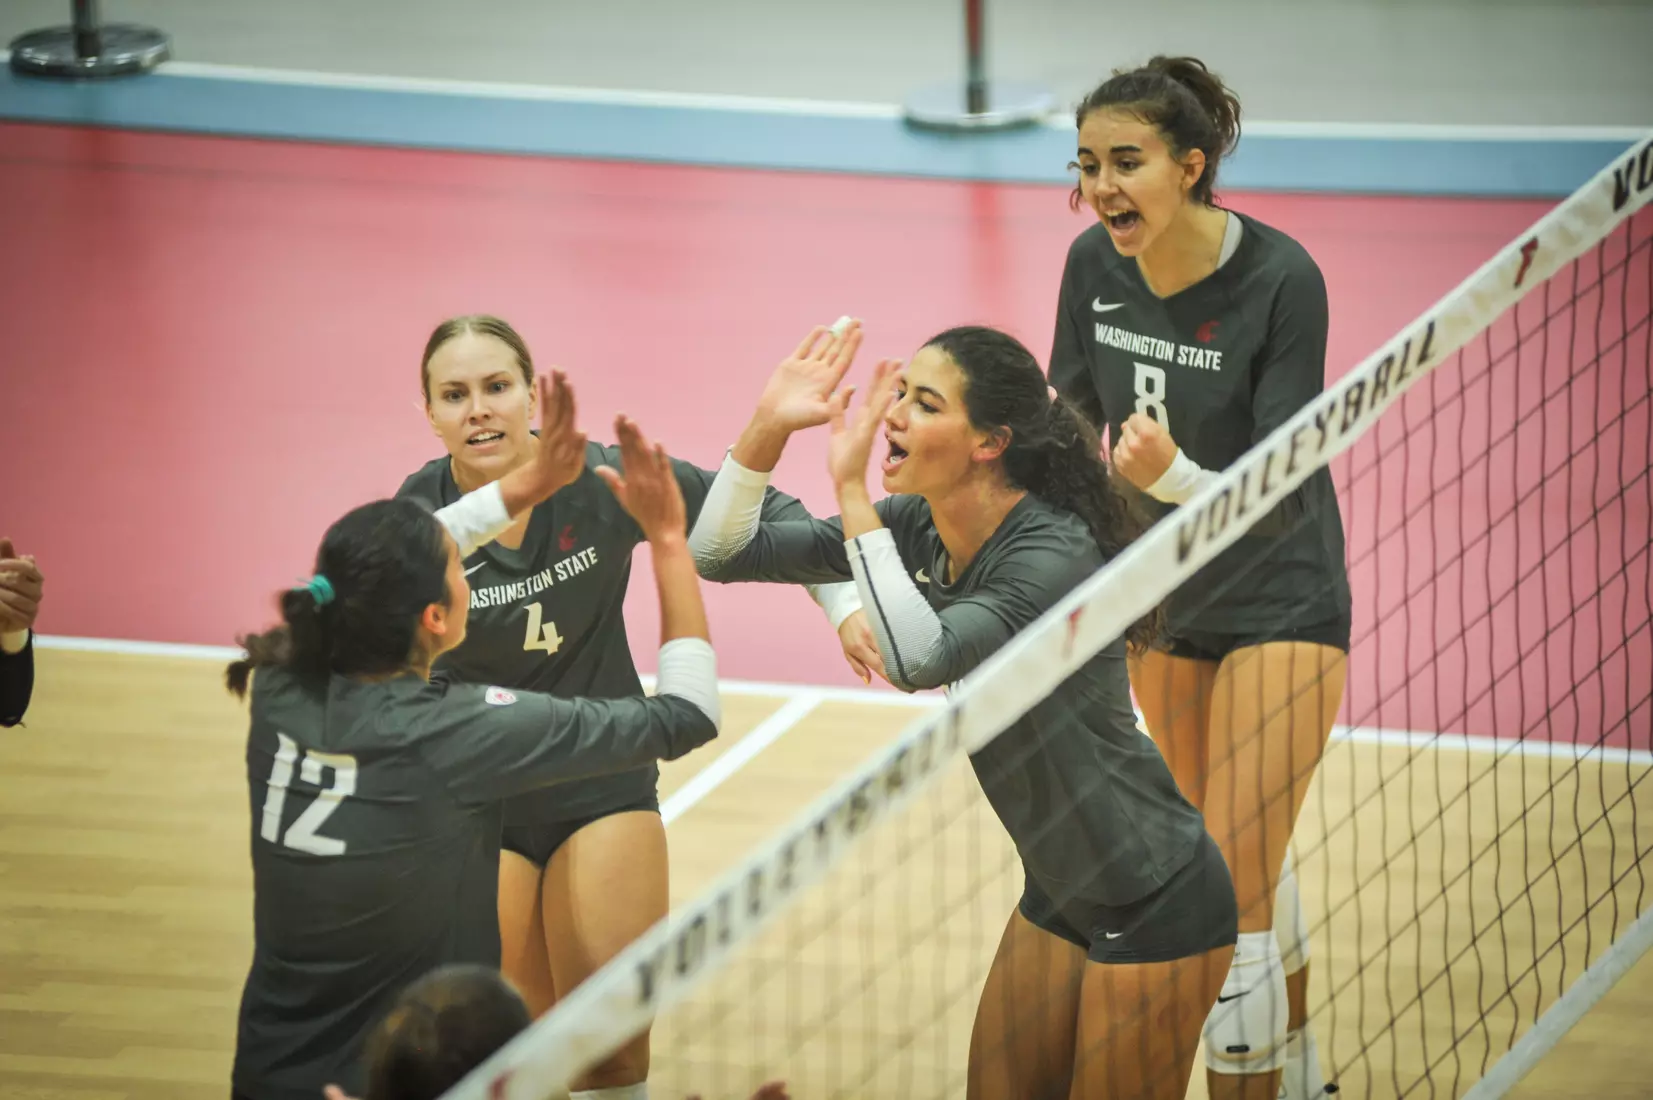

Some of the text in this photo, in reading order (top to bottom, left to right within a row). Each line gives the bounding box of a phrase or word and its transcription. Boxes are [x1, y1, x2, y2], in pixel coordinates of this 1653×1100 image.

[1095, 322, 1222, 371] WASHINGTON STATE
[1133, 361, 1170, 433] 8
[1176, 320, 1436, 564] VOLLEYBALL
[469, 546, 598, 609] ASHINGTON STATE
[523, 602, 564, 656] 4
[260, 731, 358, 856] 12
